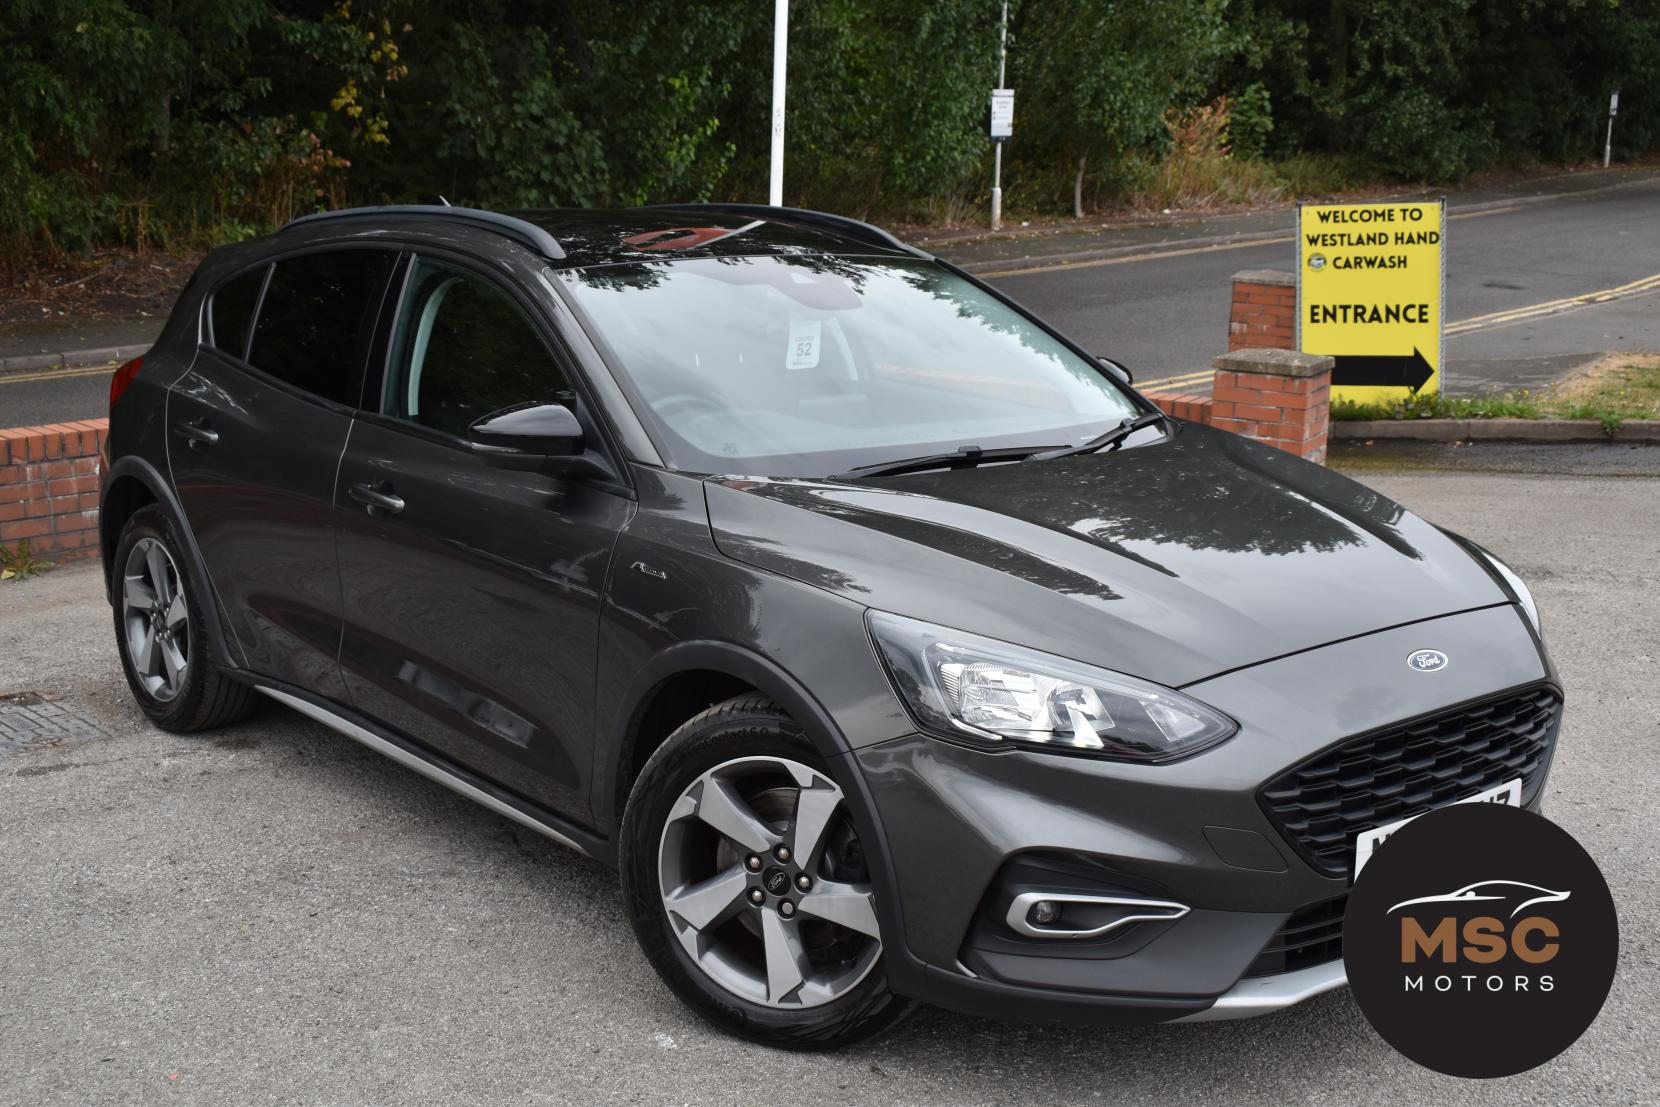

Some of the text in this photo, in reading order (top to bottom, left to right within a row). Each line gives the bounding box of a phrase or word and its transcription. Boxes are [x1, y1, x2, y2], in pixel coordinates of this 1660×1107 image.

[1317, 208, 1423, 223] WELCOME TO
[1306, 232, 1440, 246] WESTLAND HAND
[1332, 256, 1407, 269] CARWASH
[1310, 304, 1429, 324] ENTRANCE
[796, 342, 812, 356] 52
[1416, 653, 1441, 668] Ford
